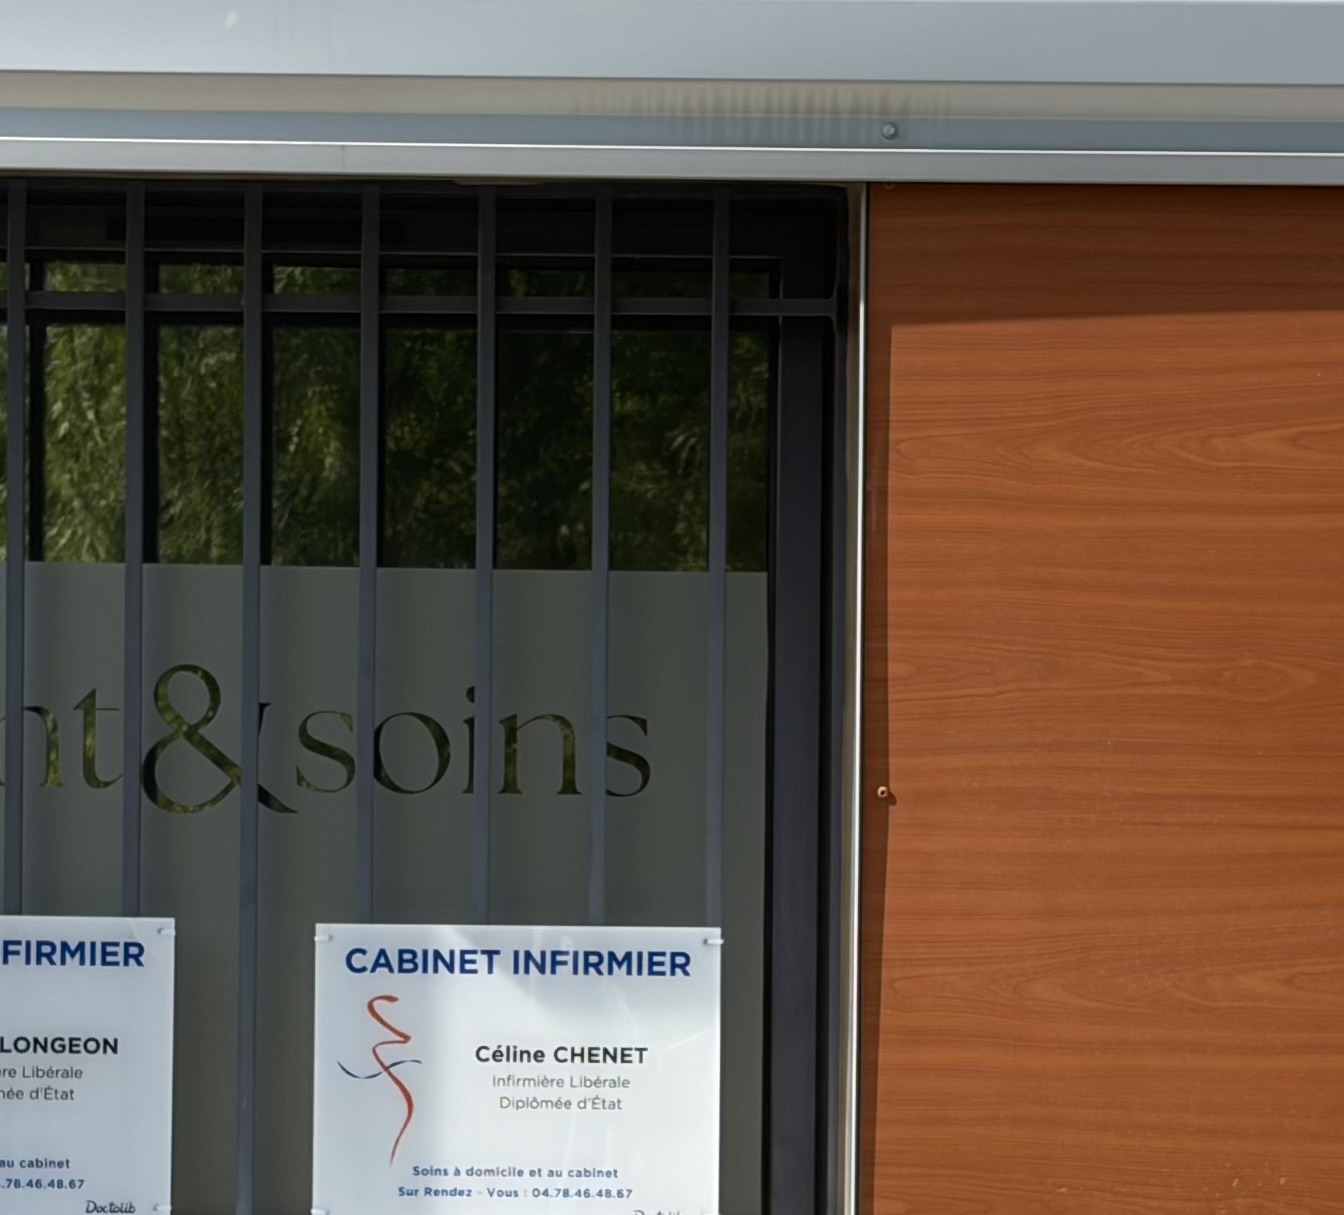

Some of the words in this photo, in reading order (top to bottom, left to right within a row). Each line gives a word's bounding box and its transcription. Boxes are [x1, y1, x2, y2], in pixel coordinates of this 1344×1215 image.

[344, 947, 502, 975] CABINET
[512, 949, 691, 977] INFIRMIER
[0, 1036, 119, 1055] LONGEON
[475, 1044, 546, 1064] Céline
[553, 1046, 649, 1064] CHENET
[22, 1065, 83, 1079] Libérale
[492, 1074, 565, 1089] Infirmière
[569, 1075, 631, 1089] Libérale
[499, 1095, 573, 1111] Diplômée
[19, 1157, 70, 1169] cabinet
[412, 1165, 449, 1177] Soins
[453, 1166, 461, 1177] à
[465, 1165, 525, 1178] domicile
[528, 1167, 543, 1178] et
[547, 1169, 563, 1178] au
[567, 1167, 619, 1179] cabinet
[397, 1186, 420, 1197] Sur
[423, 1186, 473, 1197] Rendez
[486, 1187, 519, 1198] Vous
[531, 1187, 633, 1199] 04.78.46.48.67
[85, 1199, 136, 1215] Doctolib
